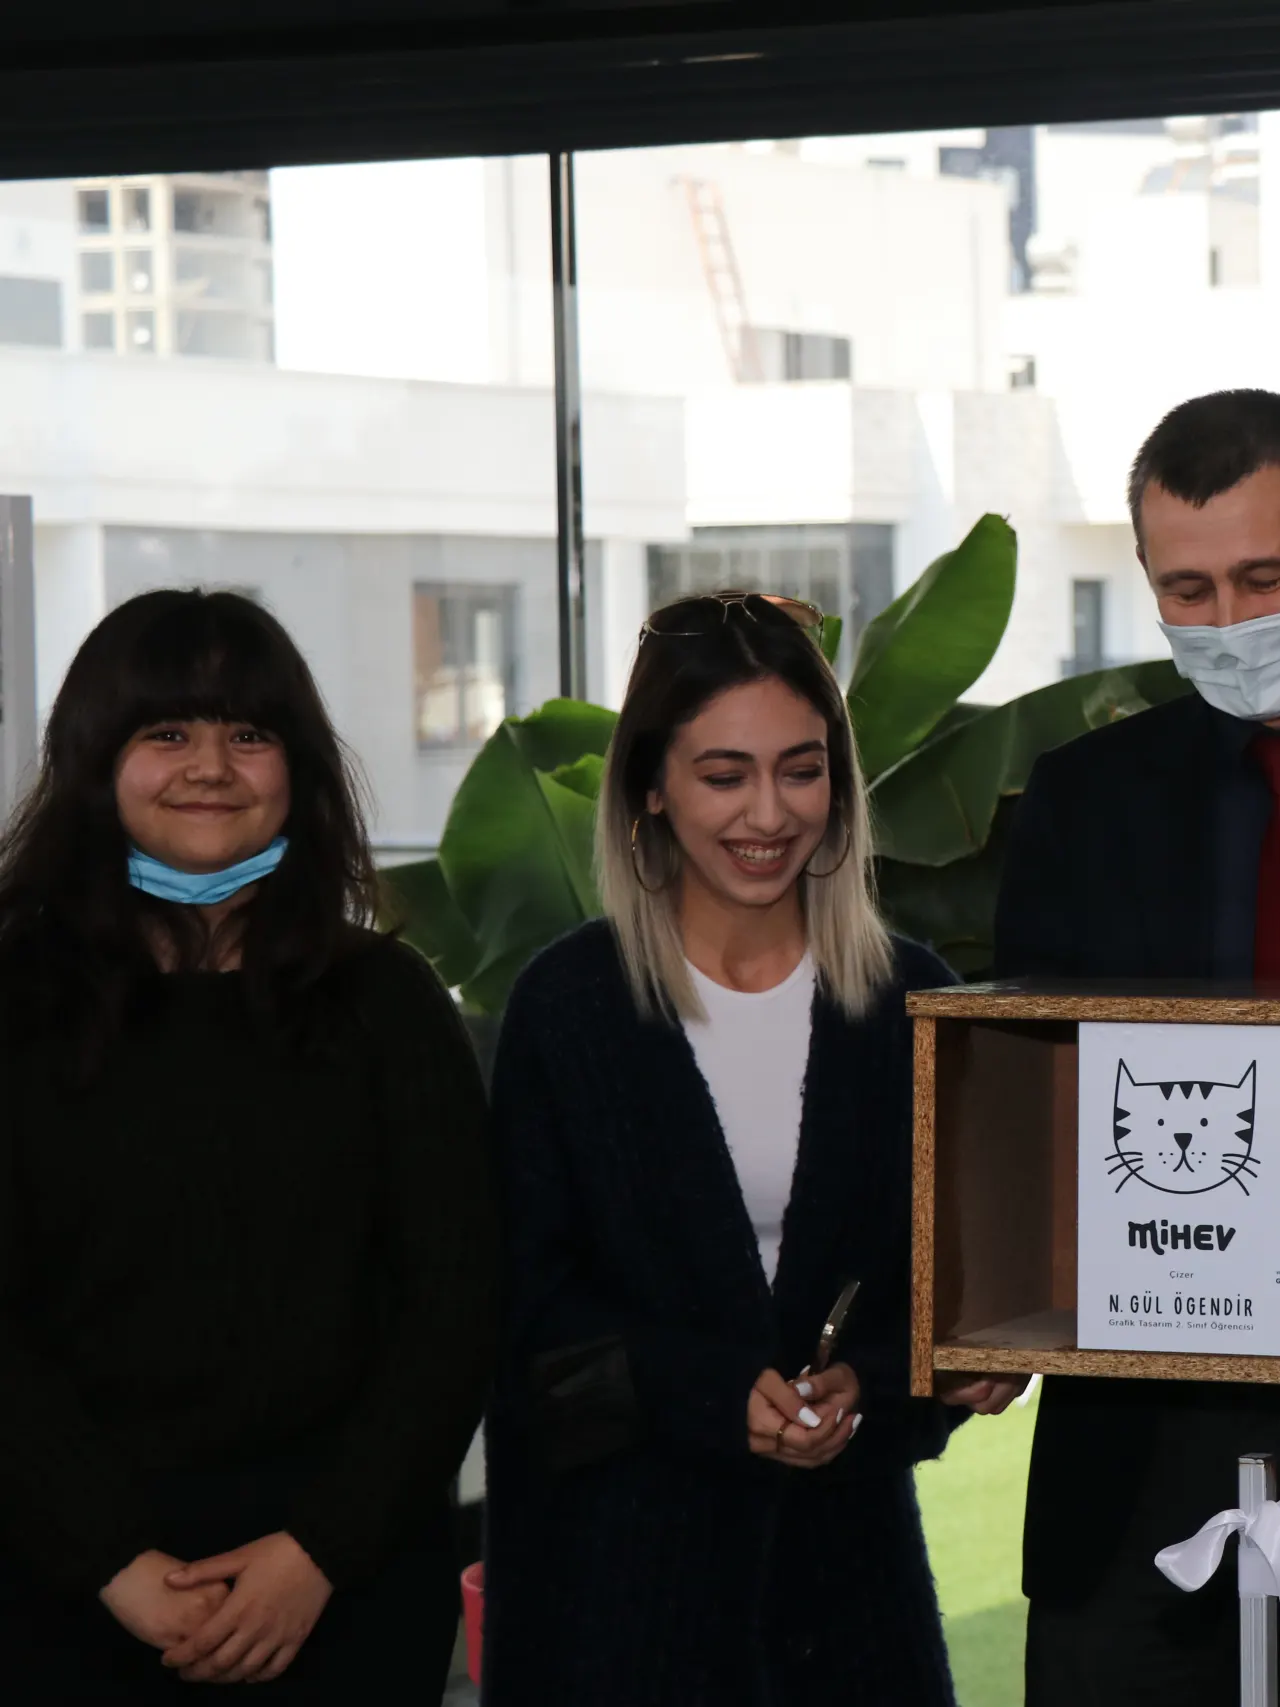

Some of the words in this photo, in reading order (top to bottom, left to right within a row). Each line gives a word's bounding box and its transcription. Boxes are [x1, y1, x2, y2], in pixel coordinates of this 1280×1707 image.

[1109, 1294, 1123, 1313] N.
[1130, 1290, 1162, 1314] GÜL
[1174, 1291, 1252, 1317] ÖGENDİR
[1108, 1318, 1135, 1327] Grafik
[1139, 1319, 1172, 1328] Tasarım
[1210, 1321, 1254, 1331] Öğrencisi
